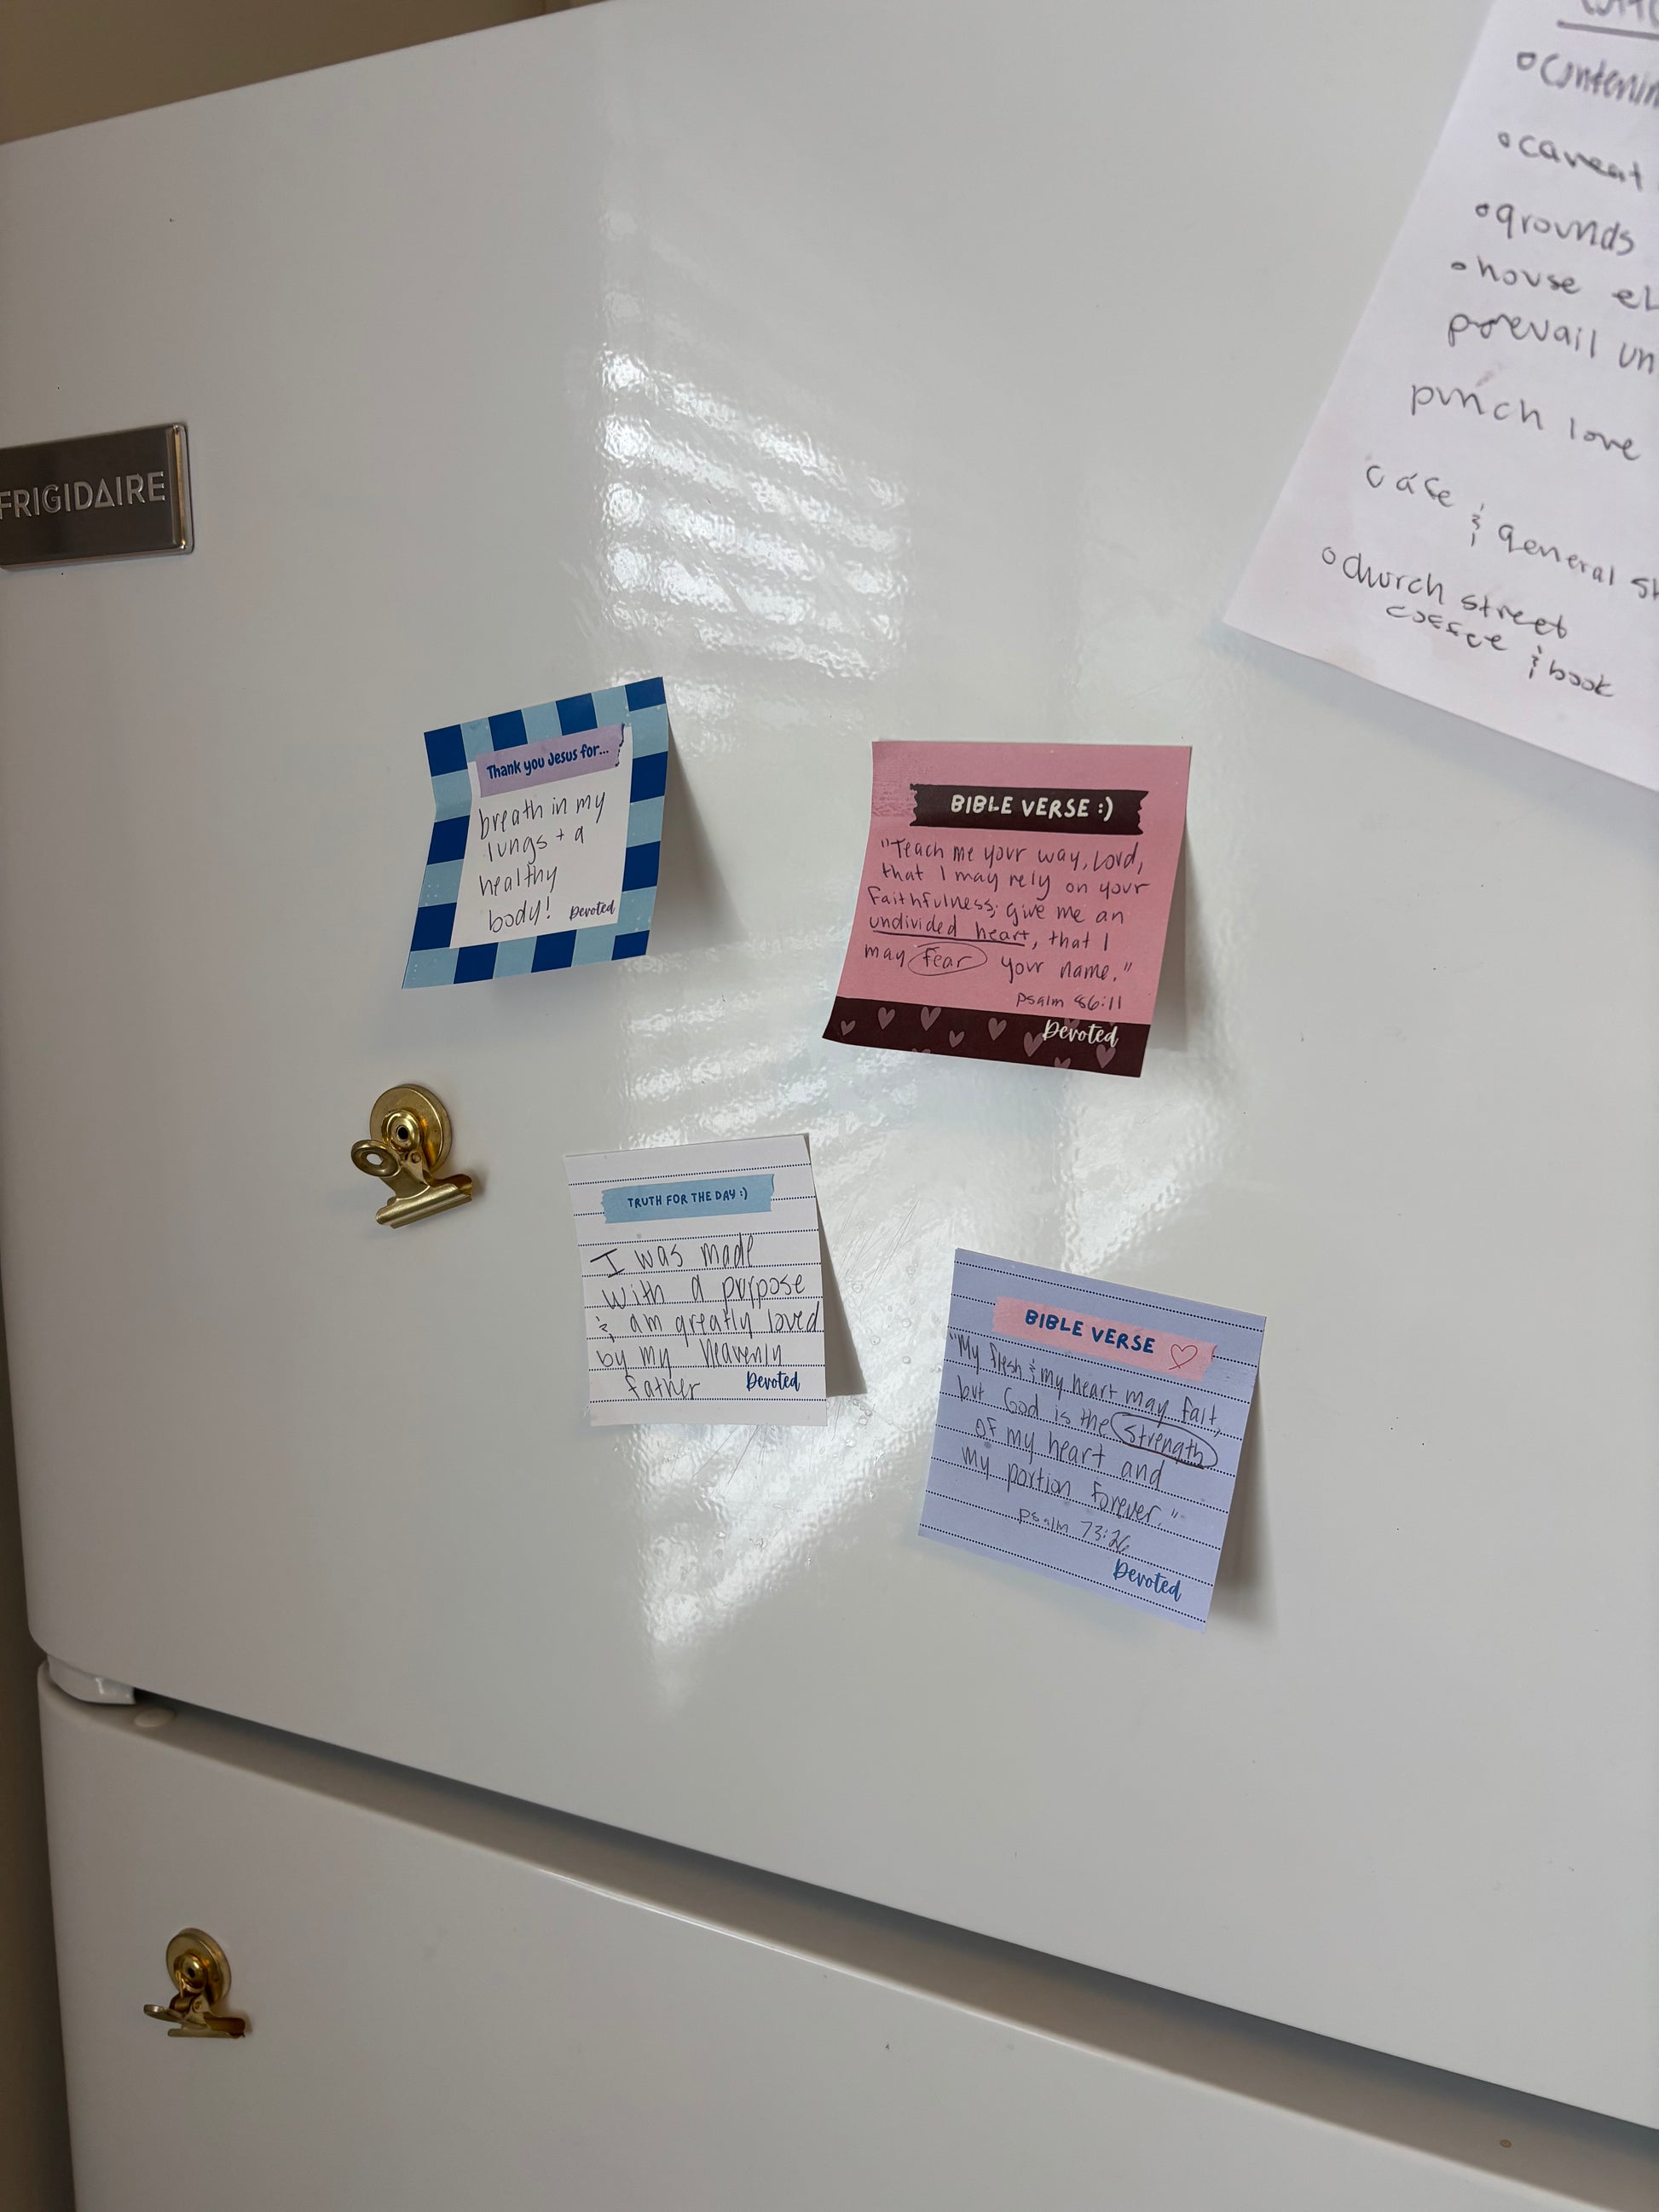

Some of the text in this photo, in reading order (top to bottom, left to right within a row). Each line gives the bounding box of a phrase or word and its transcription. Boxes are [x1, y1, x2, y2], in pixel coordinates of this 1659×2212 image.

[1477, 255, 1581, 295] house
[1411, 384, 1642, 461] punch love
[0, 471, 166, 521] FRIGIDAIRE
[1497, 523, 1616, 586] general
[1460, 594, 1568, 639] street
[486, 759, 523, 780] Thank
[523, 757, 546, 777] you
[547, 748, 579, 767] Jesus
[478, 791, 606, 840] breath in my
[950, 793, 1013, 816] BIBLE
[1021, 798, 1091, 819] VERSE
[487, 834, 548, 866] lungs
[574, 825, 585, 845] a
[952, 845, 974, 863] me
[984, 844, 1027, 869] your
[1038, 848, 1088, 871] way,
[1092, 840, 1143, 875] Lord,
[478, 863, 558, 897] healthy
[882, 862, 924, 882] that
[955, 871, 998, 892] may
[1009, 870, 1050, 901] rely
[1065, 881, 1089, 894] on
[1099, 881, 1151, 900] your
[488, 895, 552, 933] body!
[569, 898, 616, 921] Devoted
[1006, 902, 1046, 927] give
[1056, 905, 1085, 924] me
[1095, 910, 1124, 925] an
[869, 912, 957, 938] undivided
[975, 921, 1038, 950] heart,
[1049, 930, 1090, 950] that
[864, 944, 906, 968] may
[922, 945, 973, 969] fear
[1001, 956, 1045, 985] your
[1073, 994, 1122, 1011] 86:11
[1041, 1019, 1119, 1048] Devoted
[627, 1195, 662, 1209] TRUTH
[666, 1193, 689, 1206] FOR
[691, 1191, 713, 1204] THE
[715, 1188, 737, 1201] DAY
[589, 1232, 754, 1279] I was made
[601, 1273, 806, 1310] with a purpose
[628, 1313, 663, 1334] am
[675, 1308, 753, 1348] greatly
[767, 1300, 821, 1333] loved
[1024, 1308, 1157, 1355] BIBLE VERSE
[595, 1337, 783, 1379] by my heavenly
[746, 1371, 801, 1392] Devoted
[989, 1342, 1022, 1380] flesh
[1040, 1366, 1064, 1401] my
[1072, 1372, 1118, 1400] heart
[1124, 1389, 1170, 1428] may
[957, 1374, 985, 1402] but
[1003, 1387, 1039, 1418] God
[1054, 1404, 1071, 1424] is
[1079, 1406, 1110, 1436] the
[961, 1446, 991, 1481] my
[1007, 1462, 1072, 1493] portion
[1006, 1426, 1036, 1465] my
[1048, 1430, 1107, 1469] heart
[1119, 1458, 1166, 1492] and
[1112, 1557, 1182, 1603] Devoted
